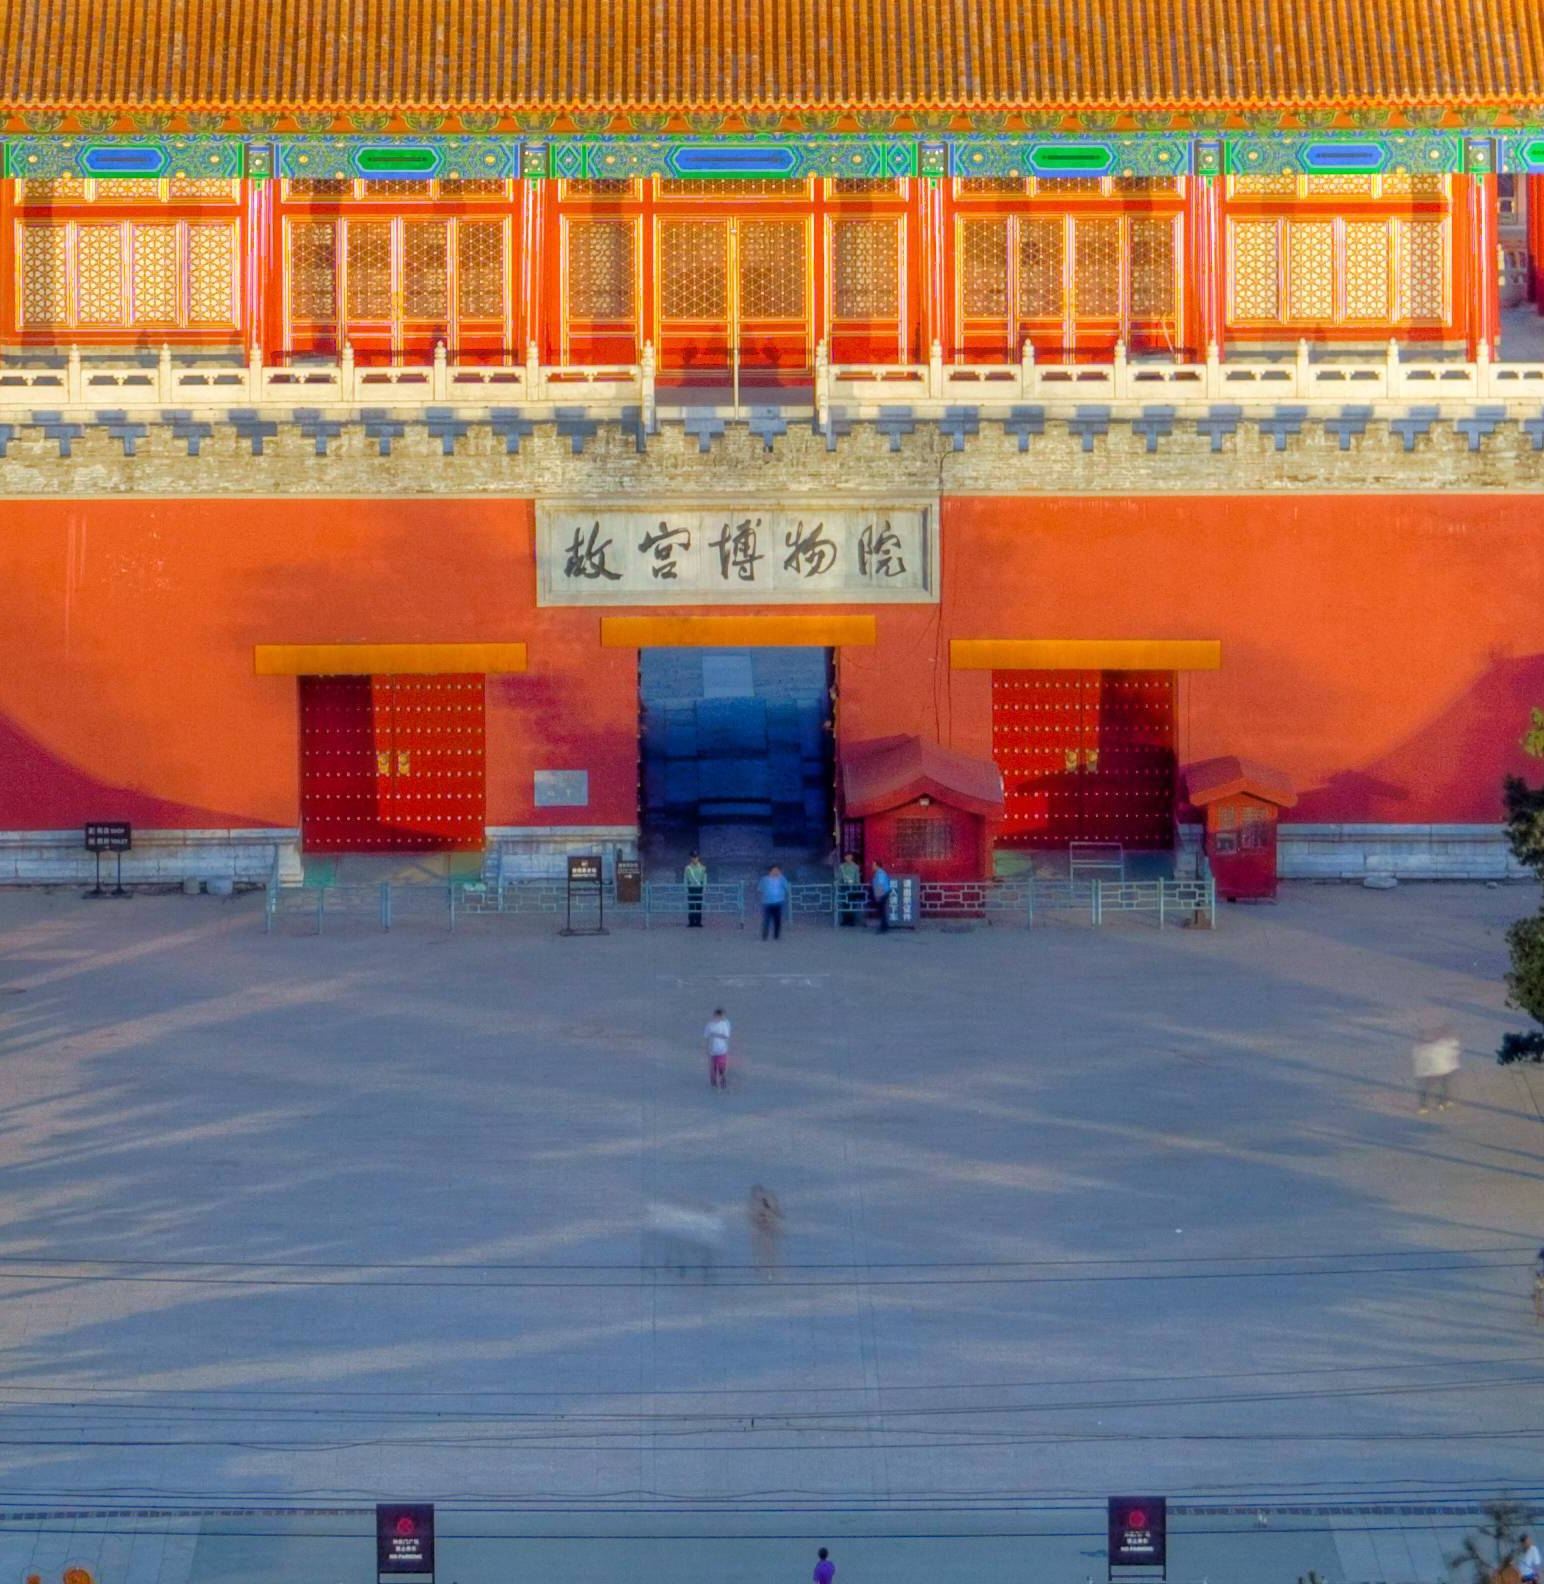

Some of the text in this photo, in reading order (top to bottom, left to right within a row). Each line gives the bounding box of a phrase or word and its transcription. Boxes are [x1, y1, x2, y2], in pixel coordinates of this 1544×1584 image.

[564, 519, 908, 581] 故宫博物院
